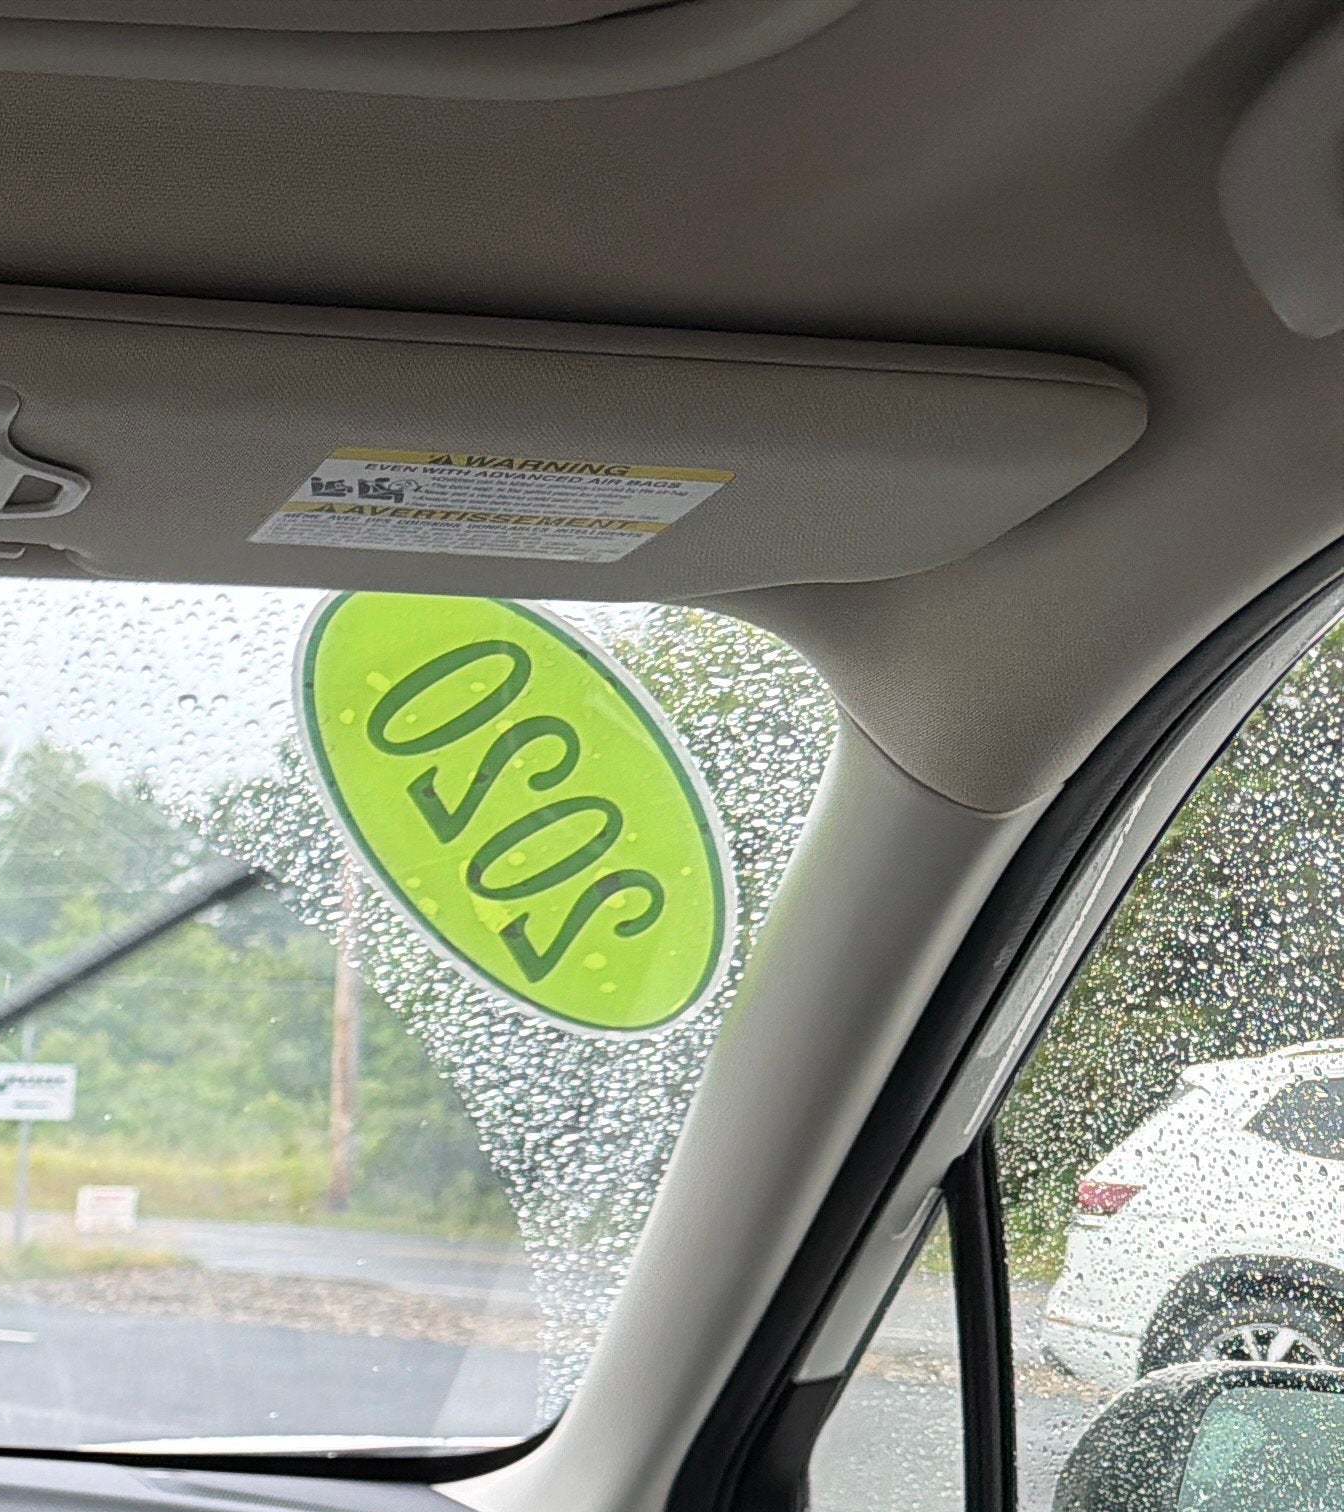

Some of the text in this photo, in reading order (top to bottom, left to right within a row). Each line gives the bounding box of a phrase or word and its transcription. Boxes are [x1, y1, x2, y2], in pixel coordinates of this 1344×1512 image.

[365, 463, 419, 473] EVEN
[422, 466, 470, 476] WITH
[476, 469, 584, 483] ADVANCED
[588, 477, 620, 486] AIR
[626, 480, 682, 489] BAGS
[465, 455, 632, 476] WARNING
[343, 504, 631, 531] AVERTISSEMENT
